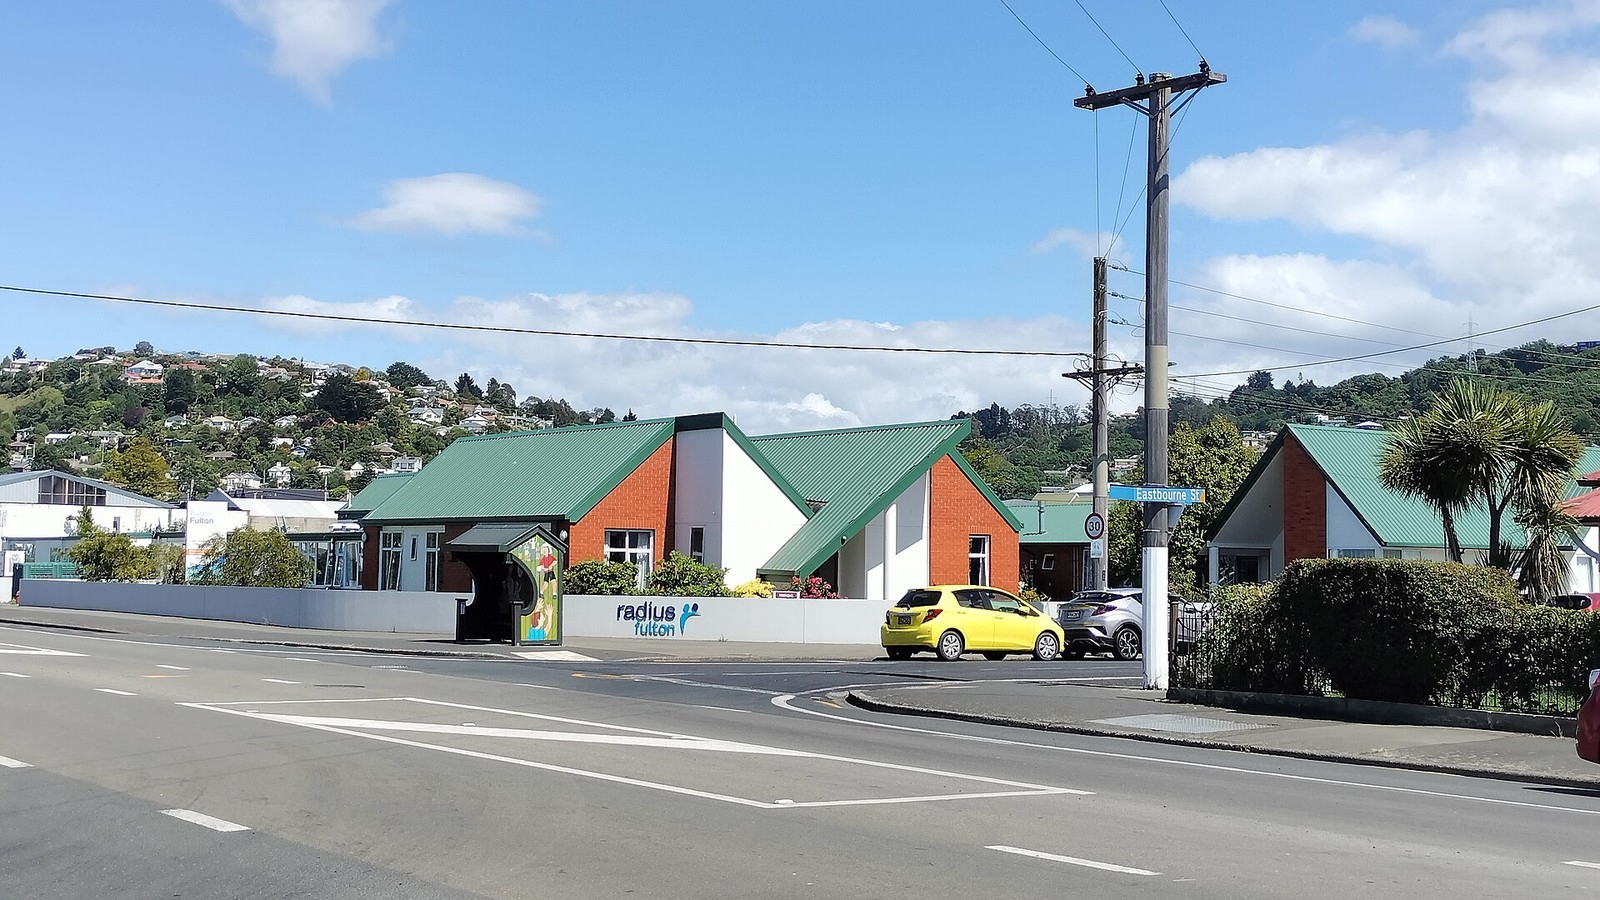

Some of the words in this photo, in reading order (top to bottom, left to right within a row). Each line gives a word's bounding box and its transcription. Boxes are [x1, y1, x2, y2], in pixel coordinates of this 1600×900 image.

[1136, 487, 1187, 501] Eastbourne
[1190, 489, 1200, 501] St
[1088, 521, 1101, 532] 30
[616, 601, 676, 622] radius
[634, 620, 675, 637] fulton
